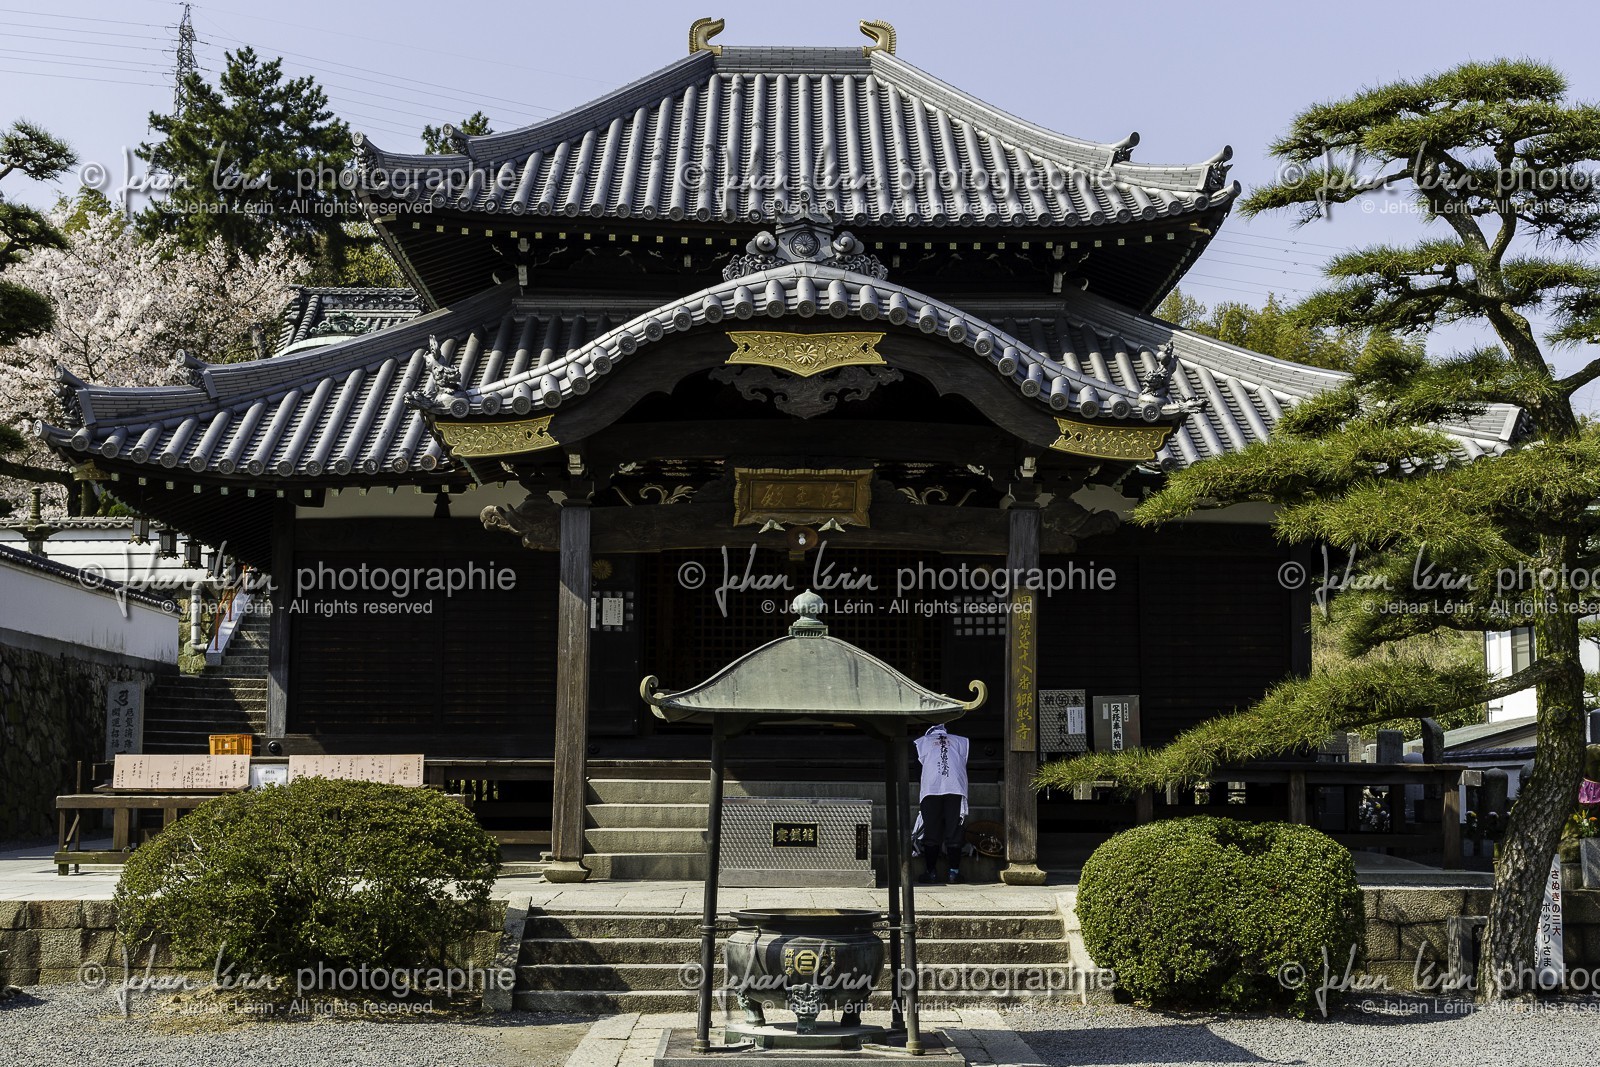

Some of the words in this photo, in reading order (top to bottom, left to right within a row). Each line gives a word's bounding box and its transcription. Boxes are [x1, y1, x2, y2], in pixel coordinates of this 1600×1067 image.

[1551, 869, 1561, 936] さぬきの三大
